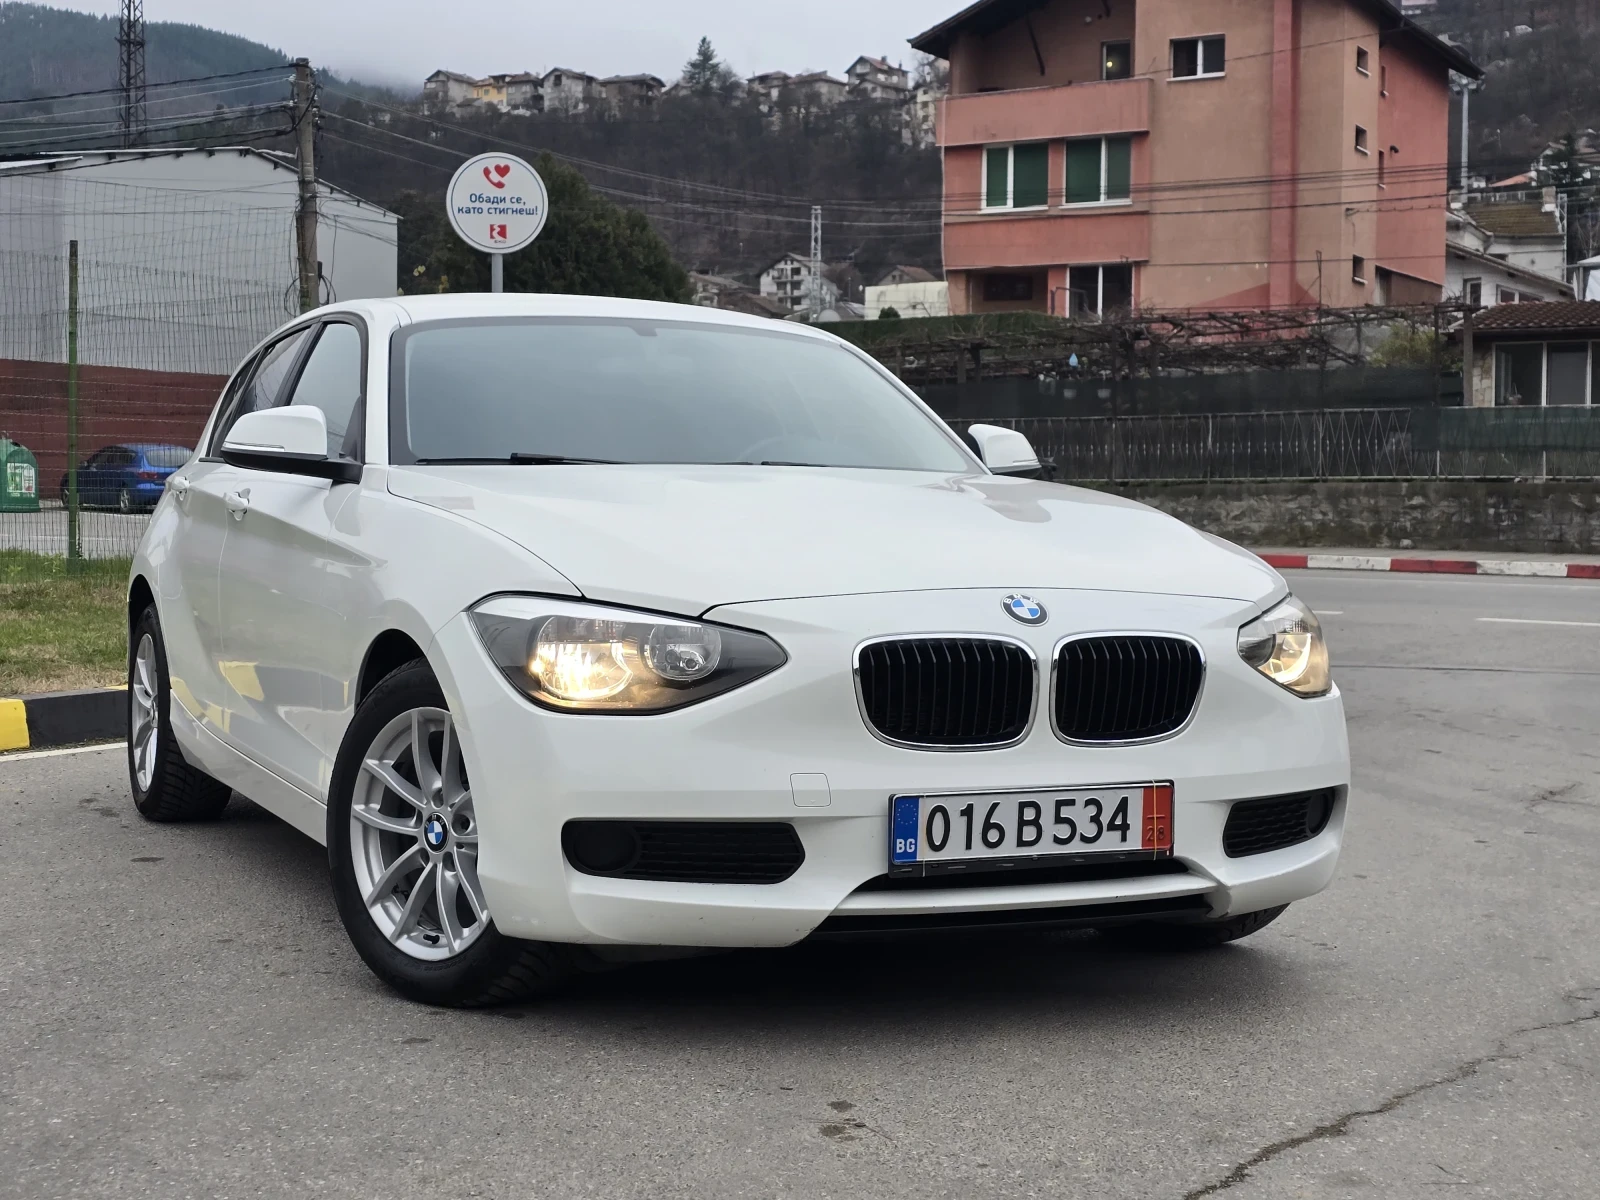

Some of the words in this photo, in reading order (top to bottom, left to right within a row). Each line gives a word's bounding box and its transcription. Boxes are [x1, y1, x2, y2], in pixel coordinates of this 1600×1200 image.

[469, 193, 507, 205] Обади
[509, 196, 526, 206] се,
[457, 206, 484, 215] като
[487, 206, 538, 215] стигнеш!
[895, 838, 916, 854] BG
